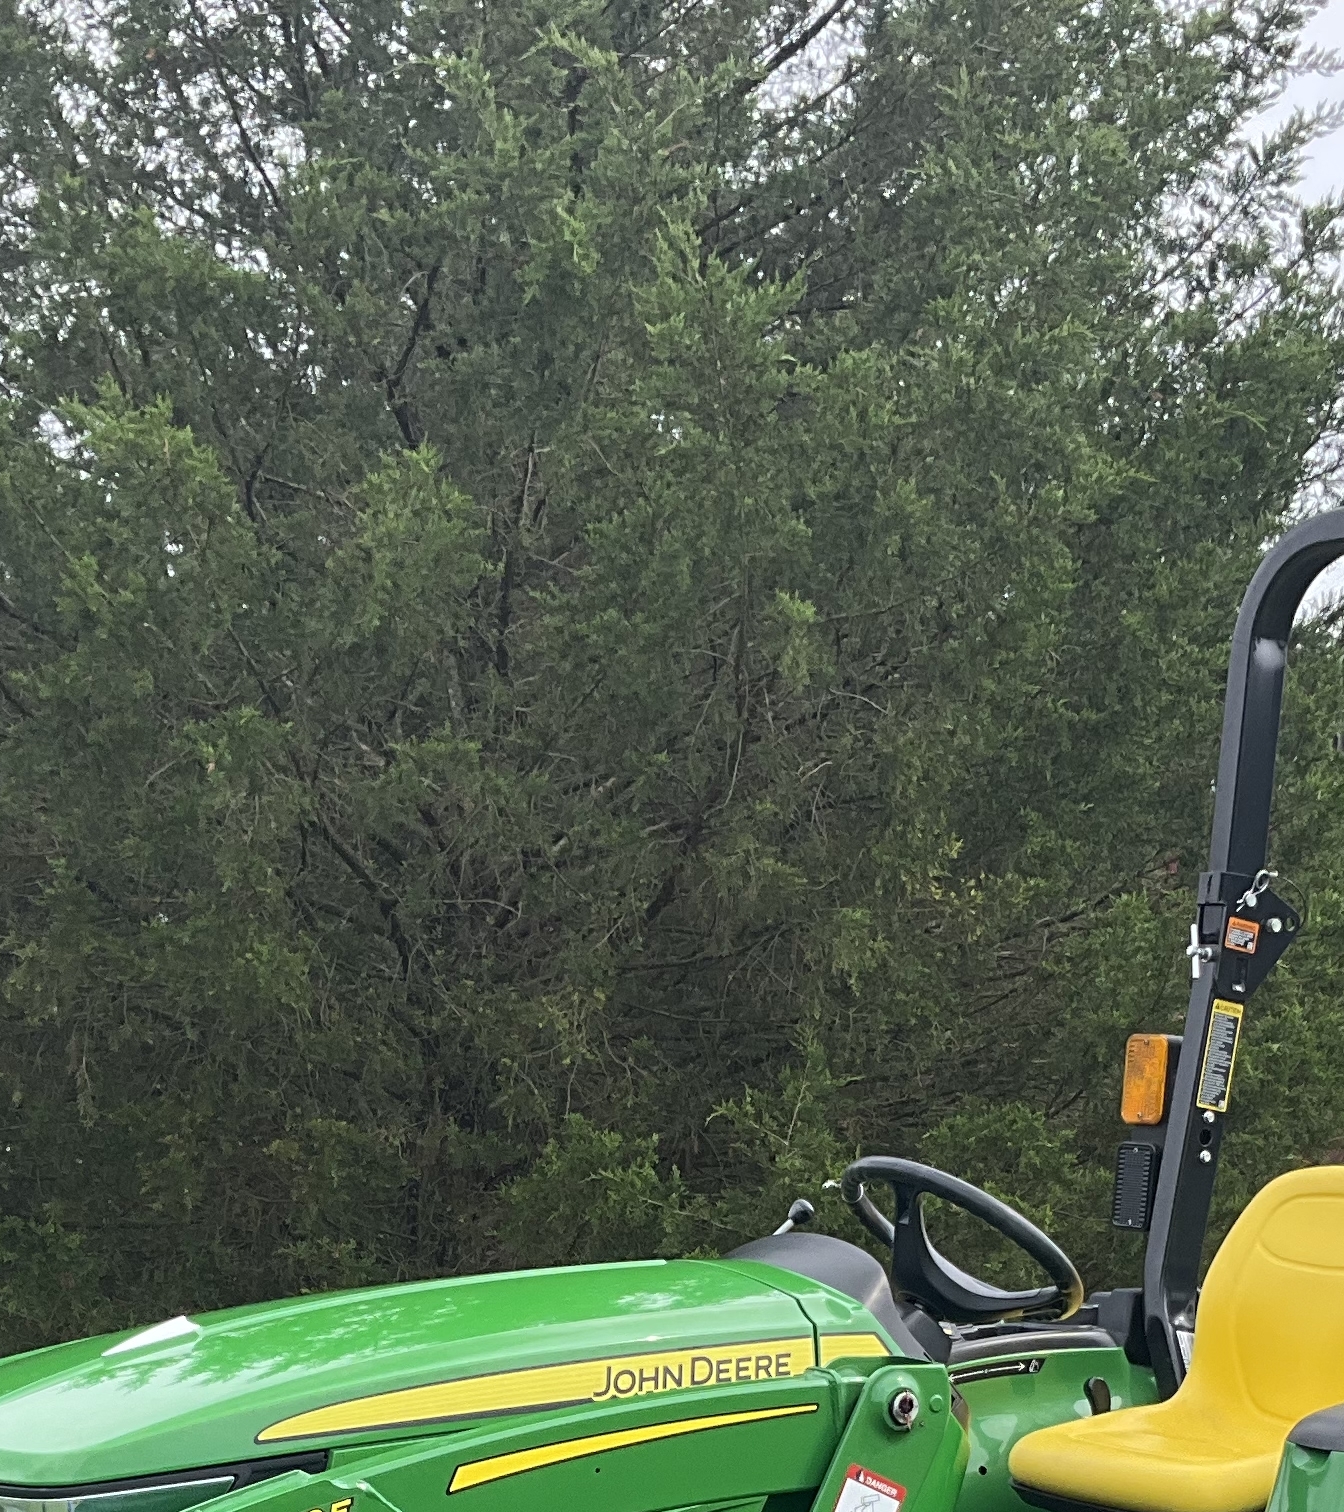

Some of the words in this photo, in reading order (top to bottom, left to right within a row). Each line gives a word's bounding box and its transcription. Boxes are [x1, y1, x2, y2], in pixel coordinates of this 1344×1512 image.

[593, 1364, 683, 1398] JOHN
[690, 1353, 792, 1386] DEERE
[865, 1476, 898, 1498] DANGER
